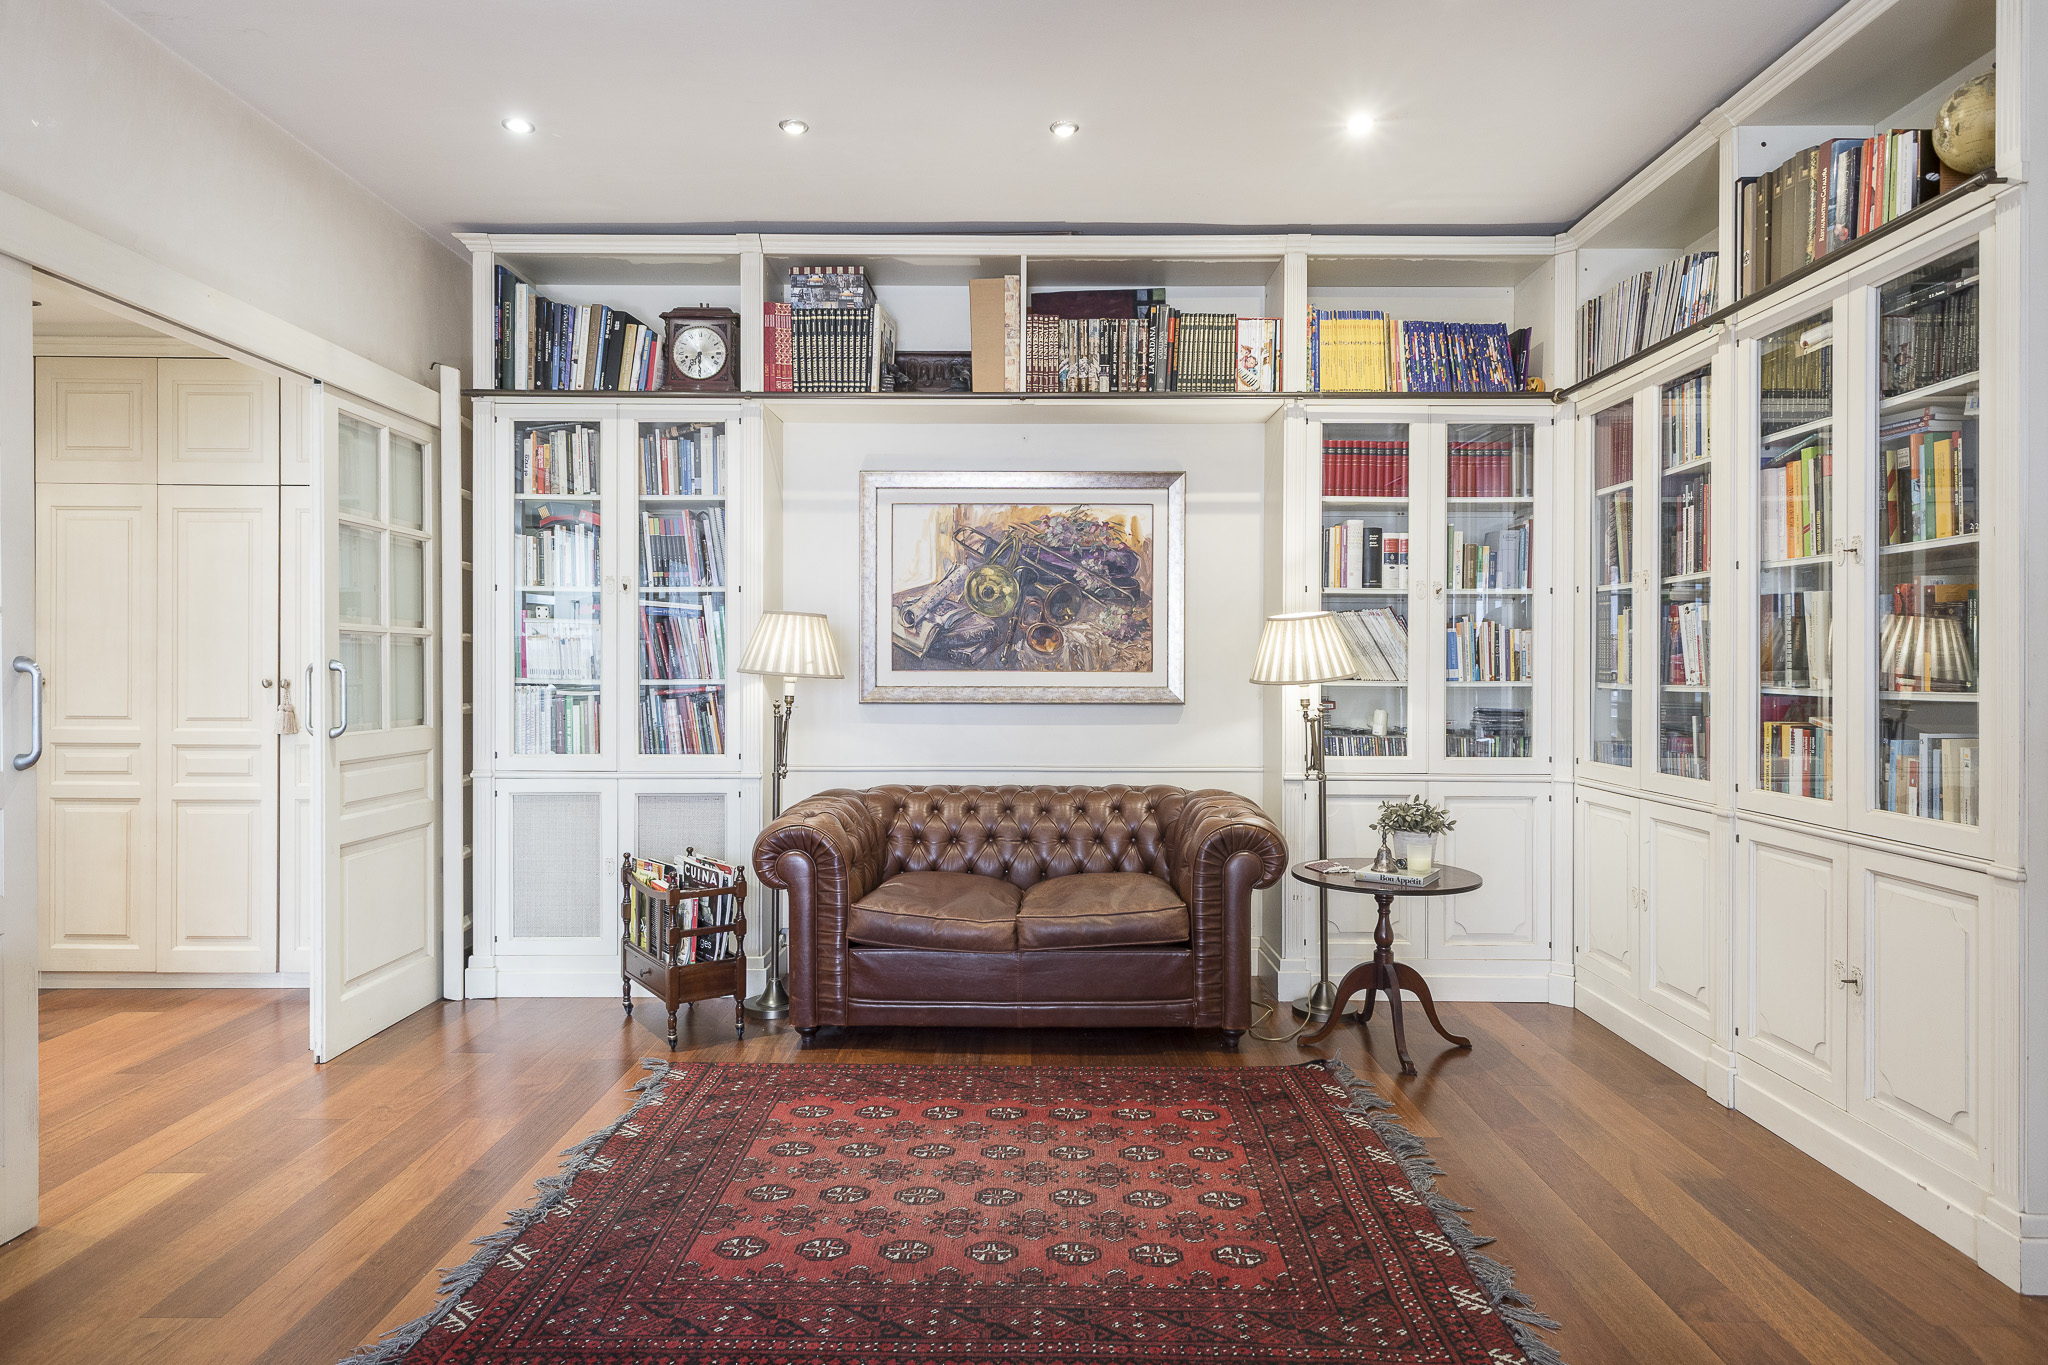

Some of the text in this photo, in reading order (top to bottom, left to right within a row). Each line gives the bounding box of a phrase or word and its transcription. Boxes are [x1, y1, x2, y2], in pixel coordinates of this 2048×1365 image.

[1149, 364, 1154, 374] LA
[684, 864, 717, 885] CUINA
[1380, 874, 1422, 885] Bon Appétit
